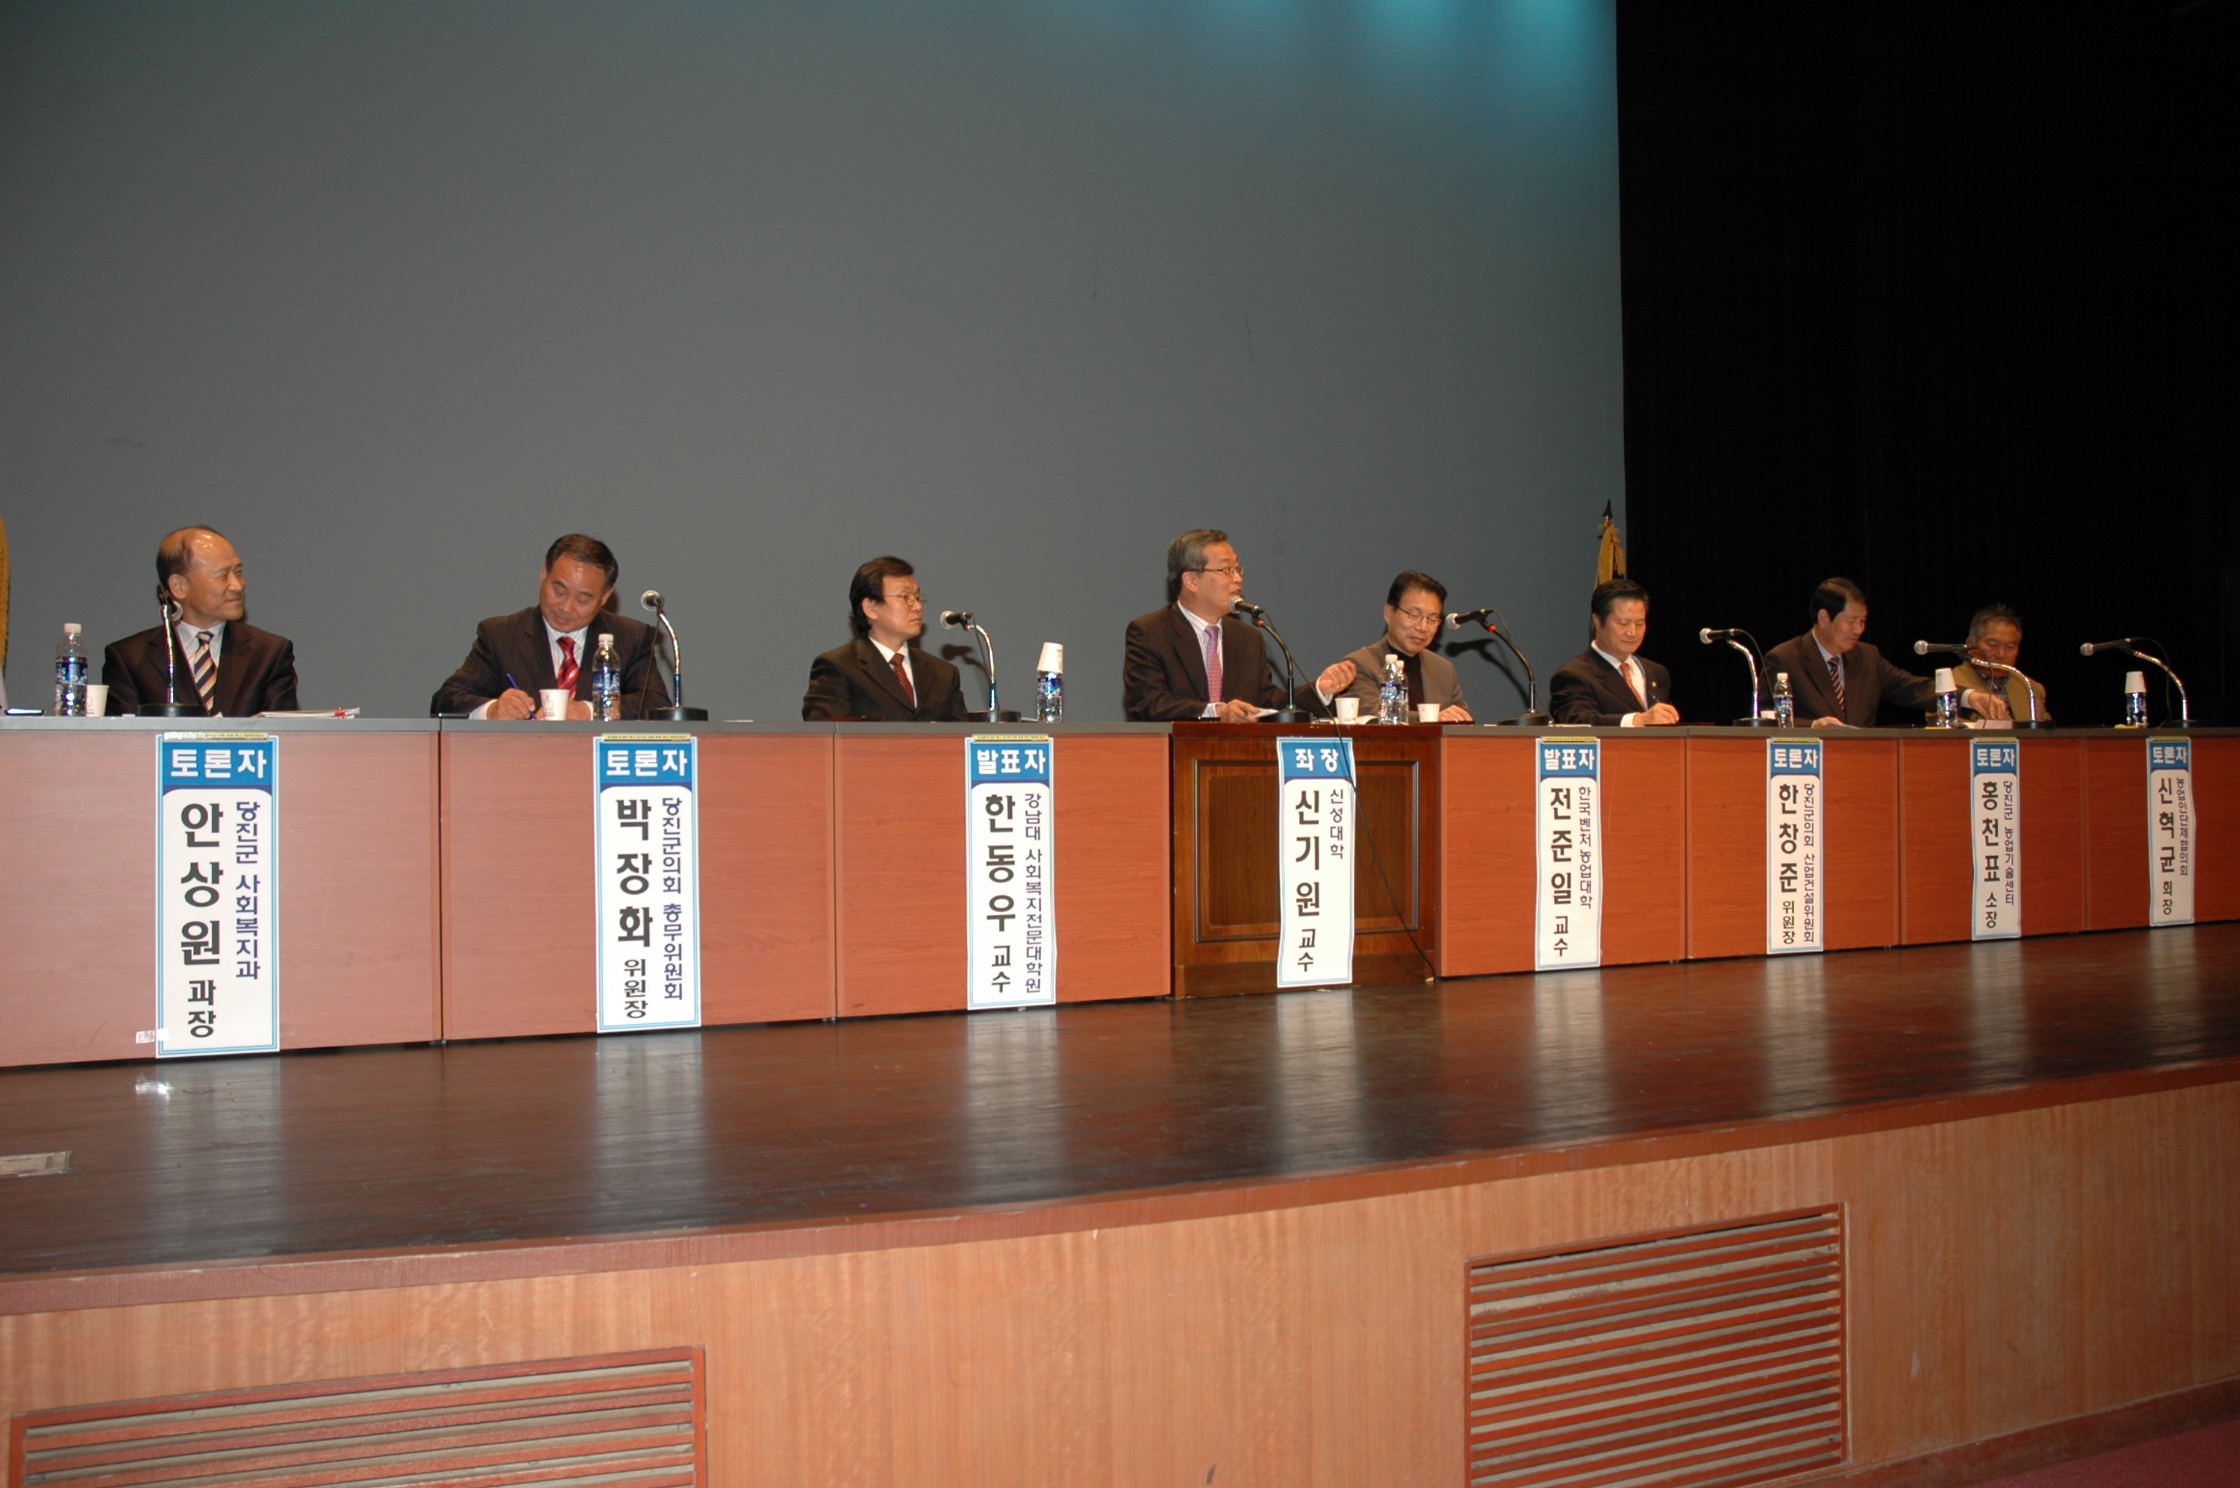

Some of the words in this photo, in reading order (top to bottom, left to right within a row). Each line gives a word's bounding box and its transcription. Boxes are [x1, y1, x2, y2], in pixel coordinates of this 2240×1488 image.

[171, 749, 267, 778] 토론자
[606, 749, 688, 776] 토론자
[977, 749, 1046, 774] 발표자
[1544, 749, 1595, 770] 발표자
[1774, 748, 1818, 768] 토론자
[1977, 748, 2015, 767] 토론자
[1025, 793, 1042, 841] 강남대
[1330, 789, 1344, 859] 신성대학
[1804, 784, 1815, 847] 당진군의회
[1981, 781, 2000, 882] 홍천표
[2004, 781, 2013, 820] 당진군
[236, 801, 260, 864] 당진군
[662, 798, 682, 894] 당진군의회
[985, 794, 1015, 932] 한동우
[1295, 790, 1320, 916] 신기원
[1550, 788, 1572, 904] 전준일
[1779, 784, 1798, 893] 한창준
[180, 803, 223, 965] 안상원
[616, 799, 653, 948] 박장화
[2004, 827, 2014, 905] 농업기술센터
[236, 874, 260, 979] 사회복지과
[1025, 848, 1043, 993] 사회복지전문대학원
[1782, 901, 1795, 944] 위원장
[1804, 853, 1815, 943] 산업건설위원회
[1985, 892, 1997, 929] 소장
[663, 904, 682, 1000] 총무위원회
[1297, 928, 1316, 972] 교수
[1554, 916, 1568, 957] 교수
[624, 959, 648, 1018] 위원장
[991, 945, 1011, 993] 교수
[188, 980, 216, 1038] 과장
